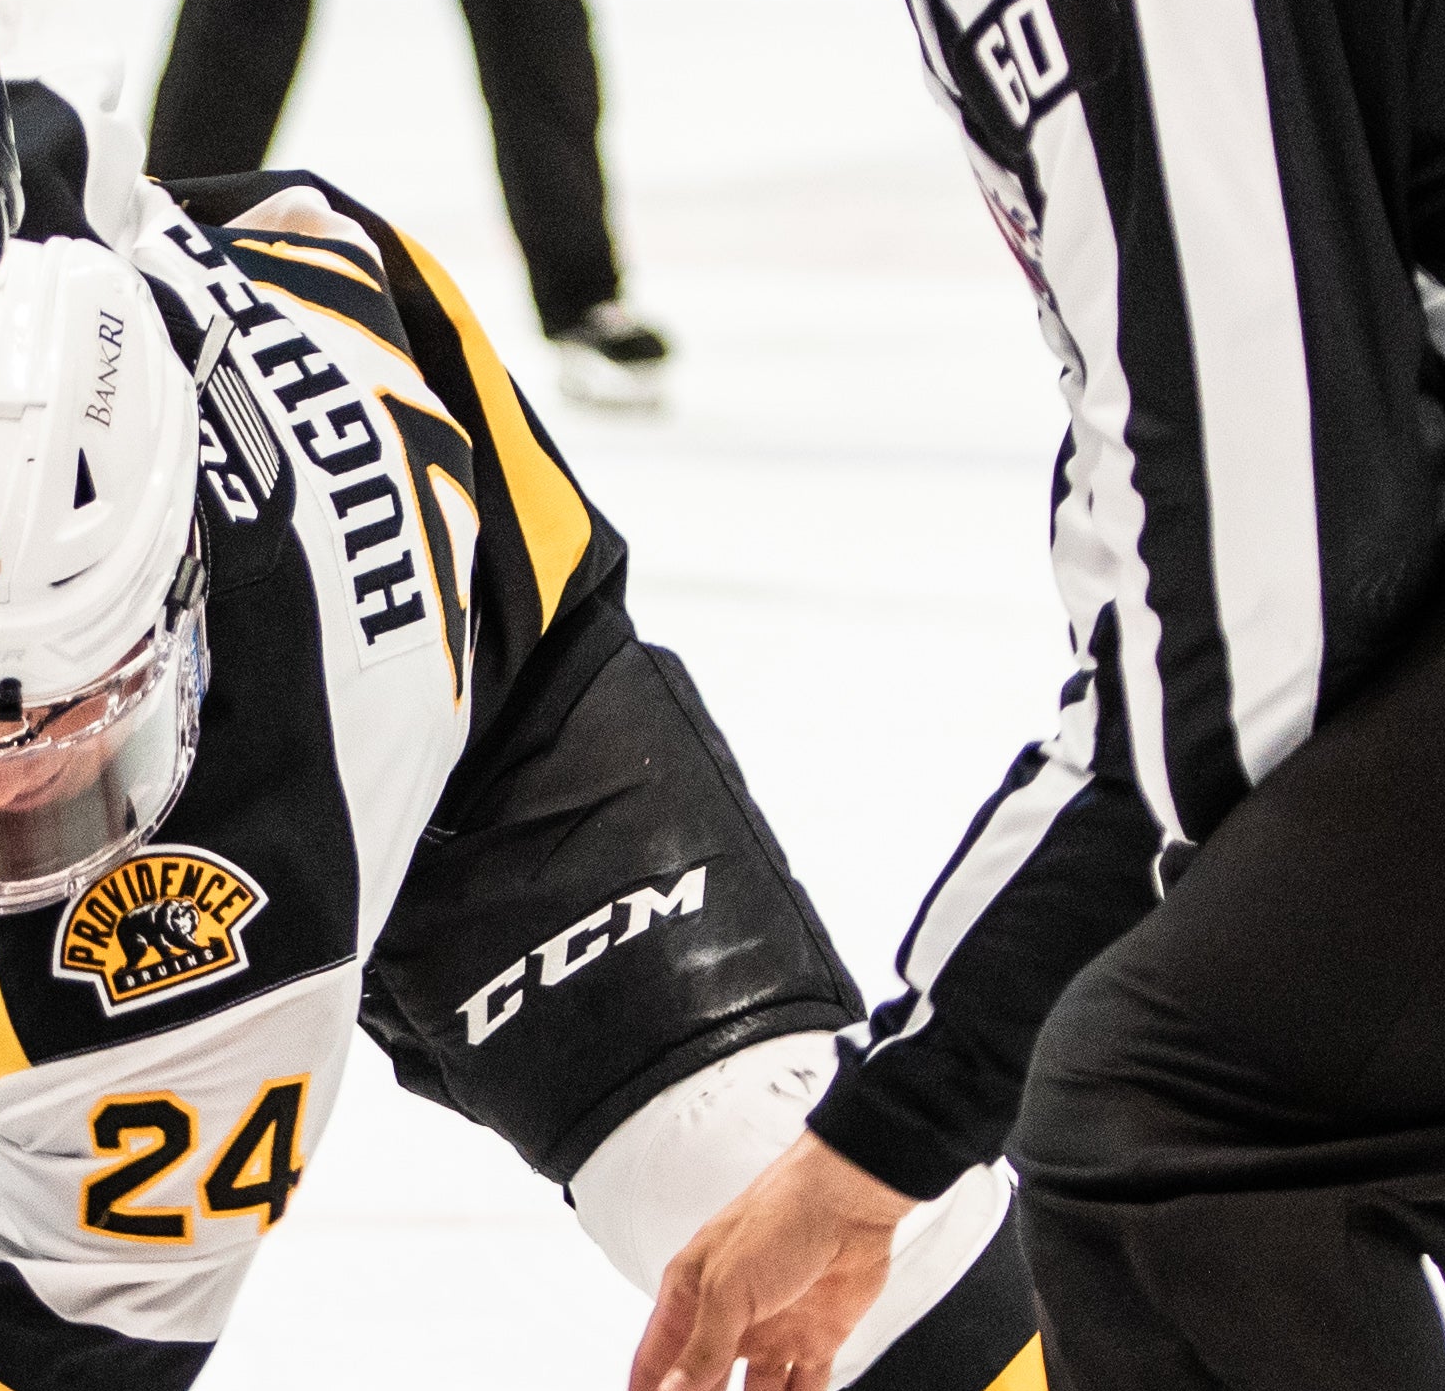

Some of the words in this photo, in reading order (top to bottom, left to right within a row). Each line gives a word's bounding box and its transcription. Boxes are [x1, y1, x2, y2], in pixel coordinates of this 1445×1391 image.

[66, 861, 251, 968] PROVIDENCE
[125, 947, 215, 988] BRUINS
[455, 865, 707, 1046] CCM
[78, 1071, 311, 1246] 24
